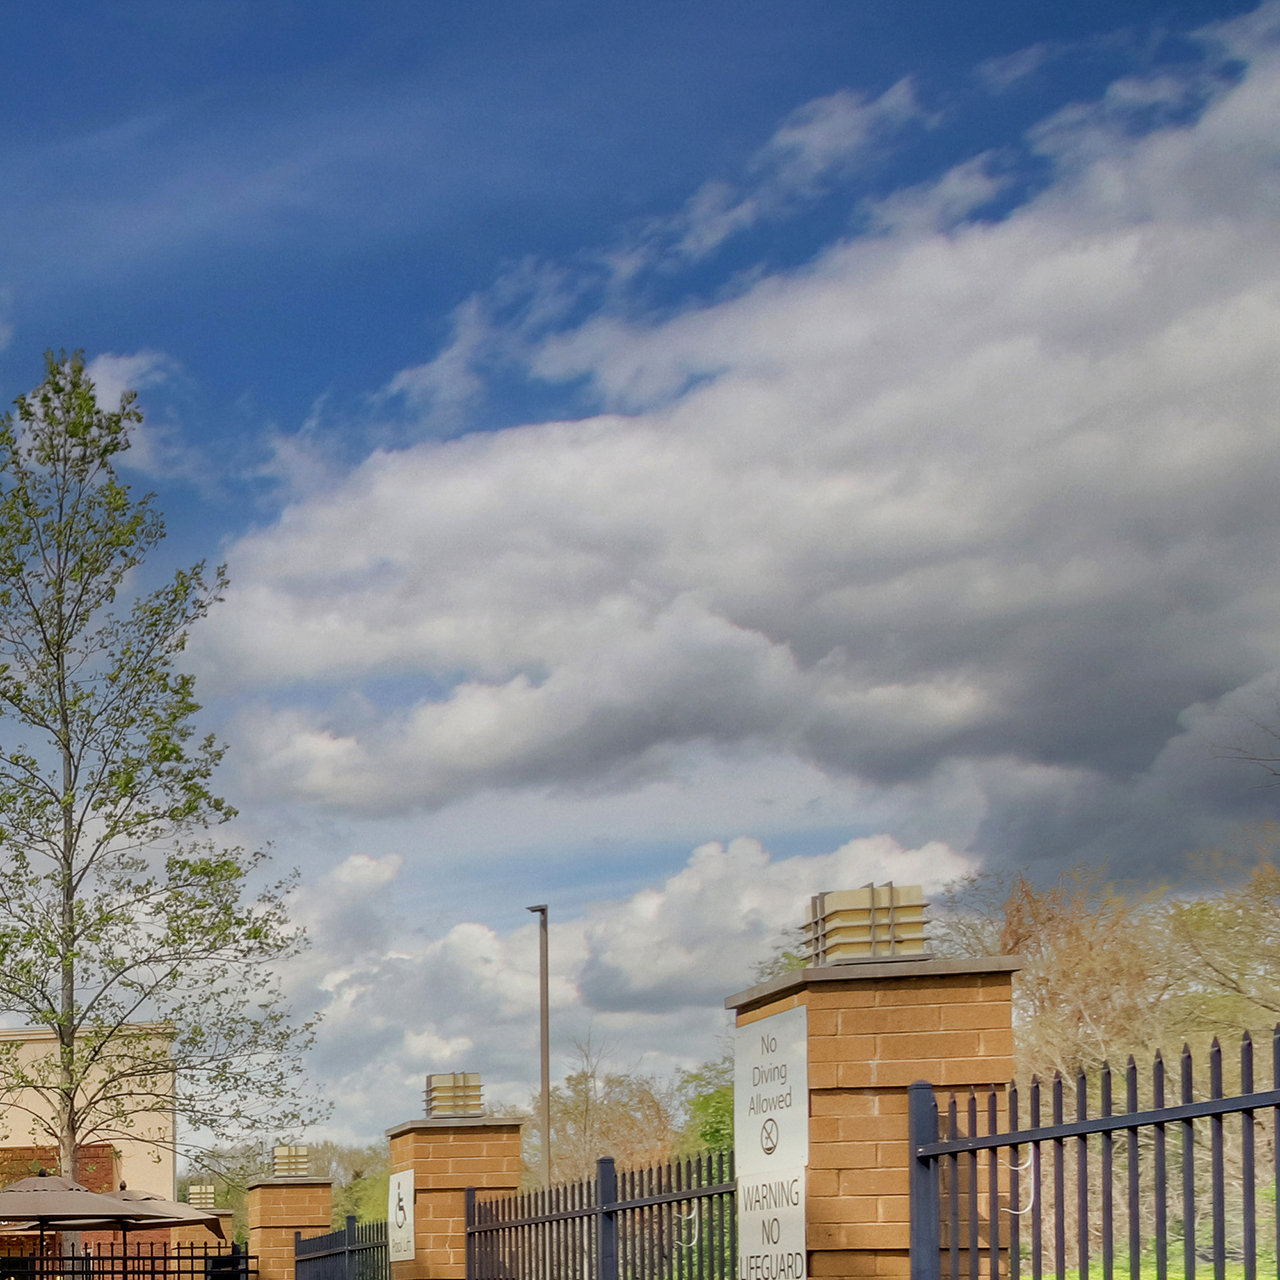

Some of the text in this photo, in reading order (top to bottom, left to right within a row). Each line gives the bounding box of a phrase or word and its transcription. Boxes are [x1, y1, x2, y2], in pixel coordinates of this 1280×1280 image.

[761, 1034, 777, 1056] No
[752, 1063, 787, 1088] Diving
[748, 1087, 792, 1117] Allowed
[742, 1178, 800, 1212] WARNING
[761, 1218, 780, 1246] NO
